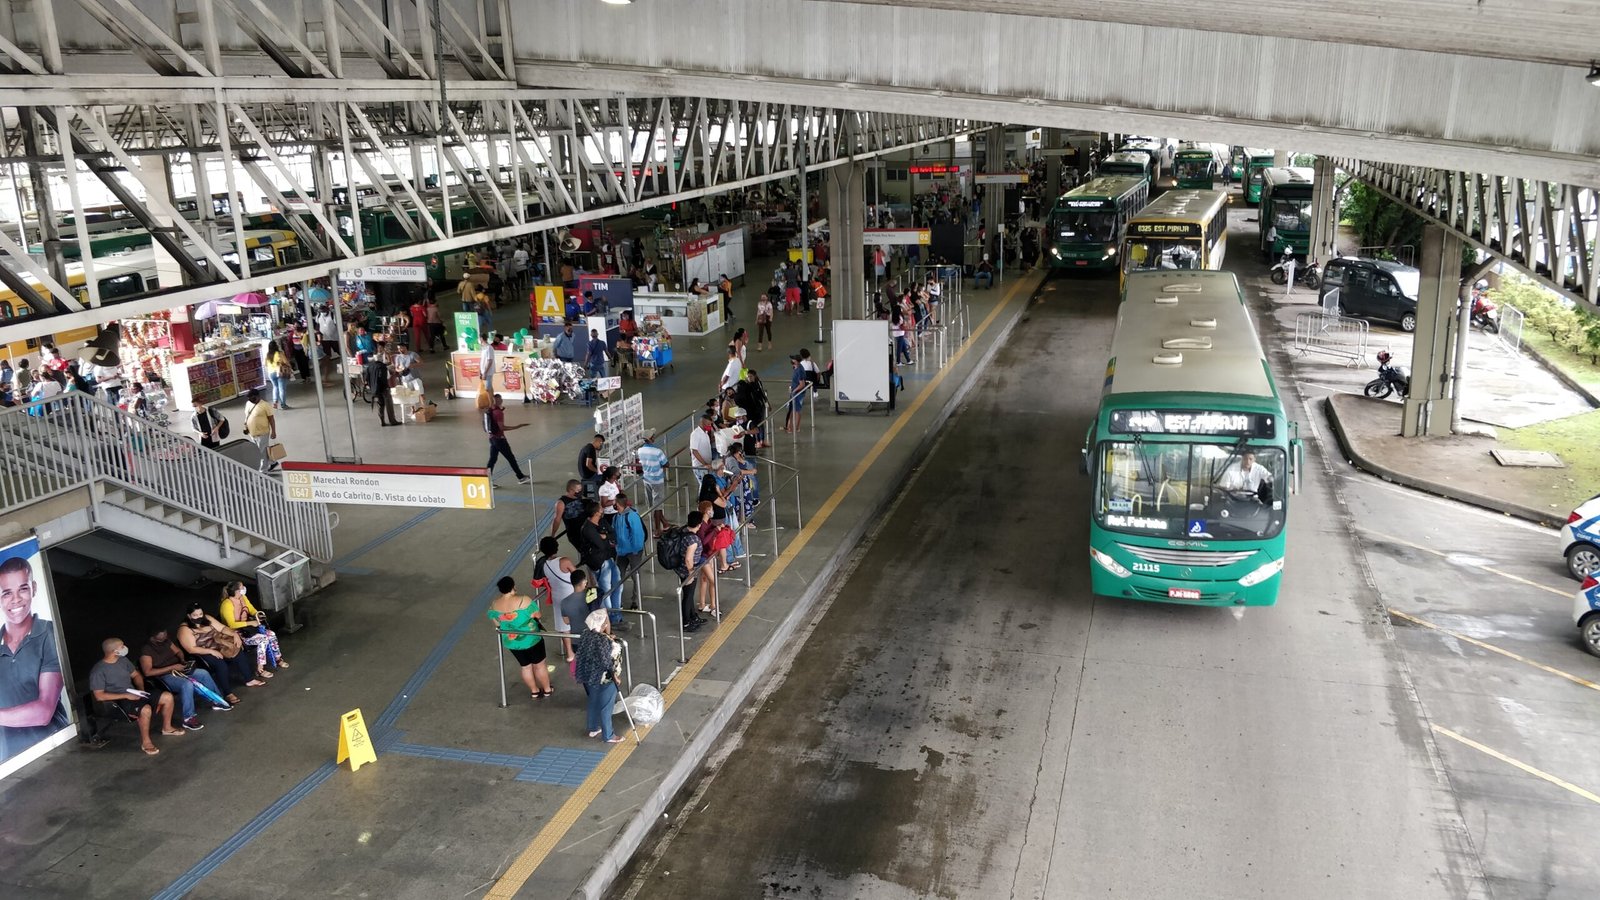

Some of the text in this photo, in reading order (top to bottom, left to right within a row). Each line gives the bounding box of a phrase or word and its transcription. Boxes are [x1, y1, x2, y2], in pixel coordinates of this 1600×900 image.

[377, 267, 417, 276] Rodoviário
[593, 282, 609, 290] TIM
[543, 289, 560, 311] A
[290, 473, 380, 486] 0325 Marechal Rondon
[291, 487, 309, 499] 1647
[314, 490, 330, 498] Alto
[332, 490, 341, 499] do
[385, 493, 405, 502] Vista
[407, 494, 417, 502] do
[419, 495, 446, 504] Lobato
[467, 483, 486, 499] 01
[1132, 562, 1159, 573] 21115
